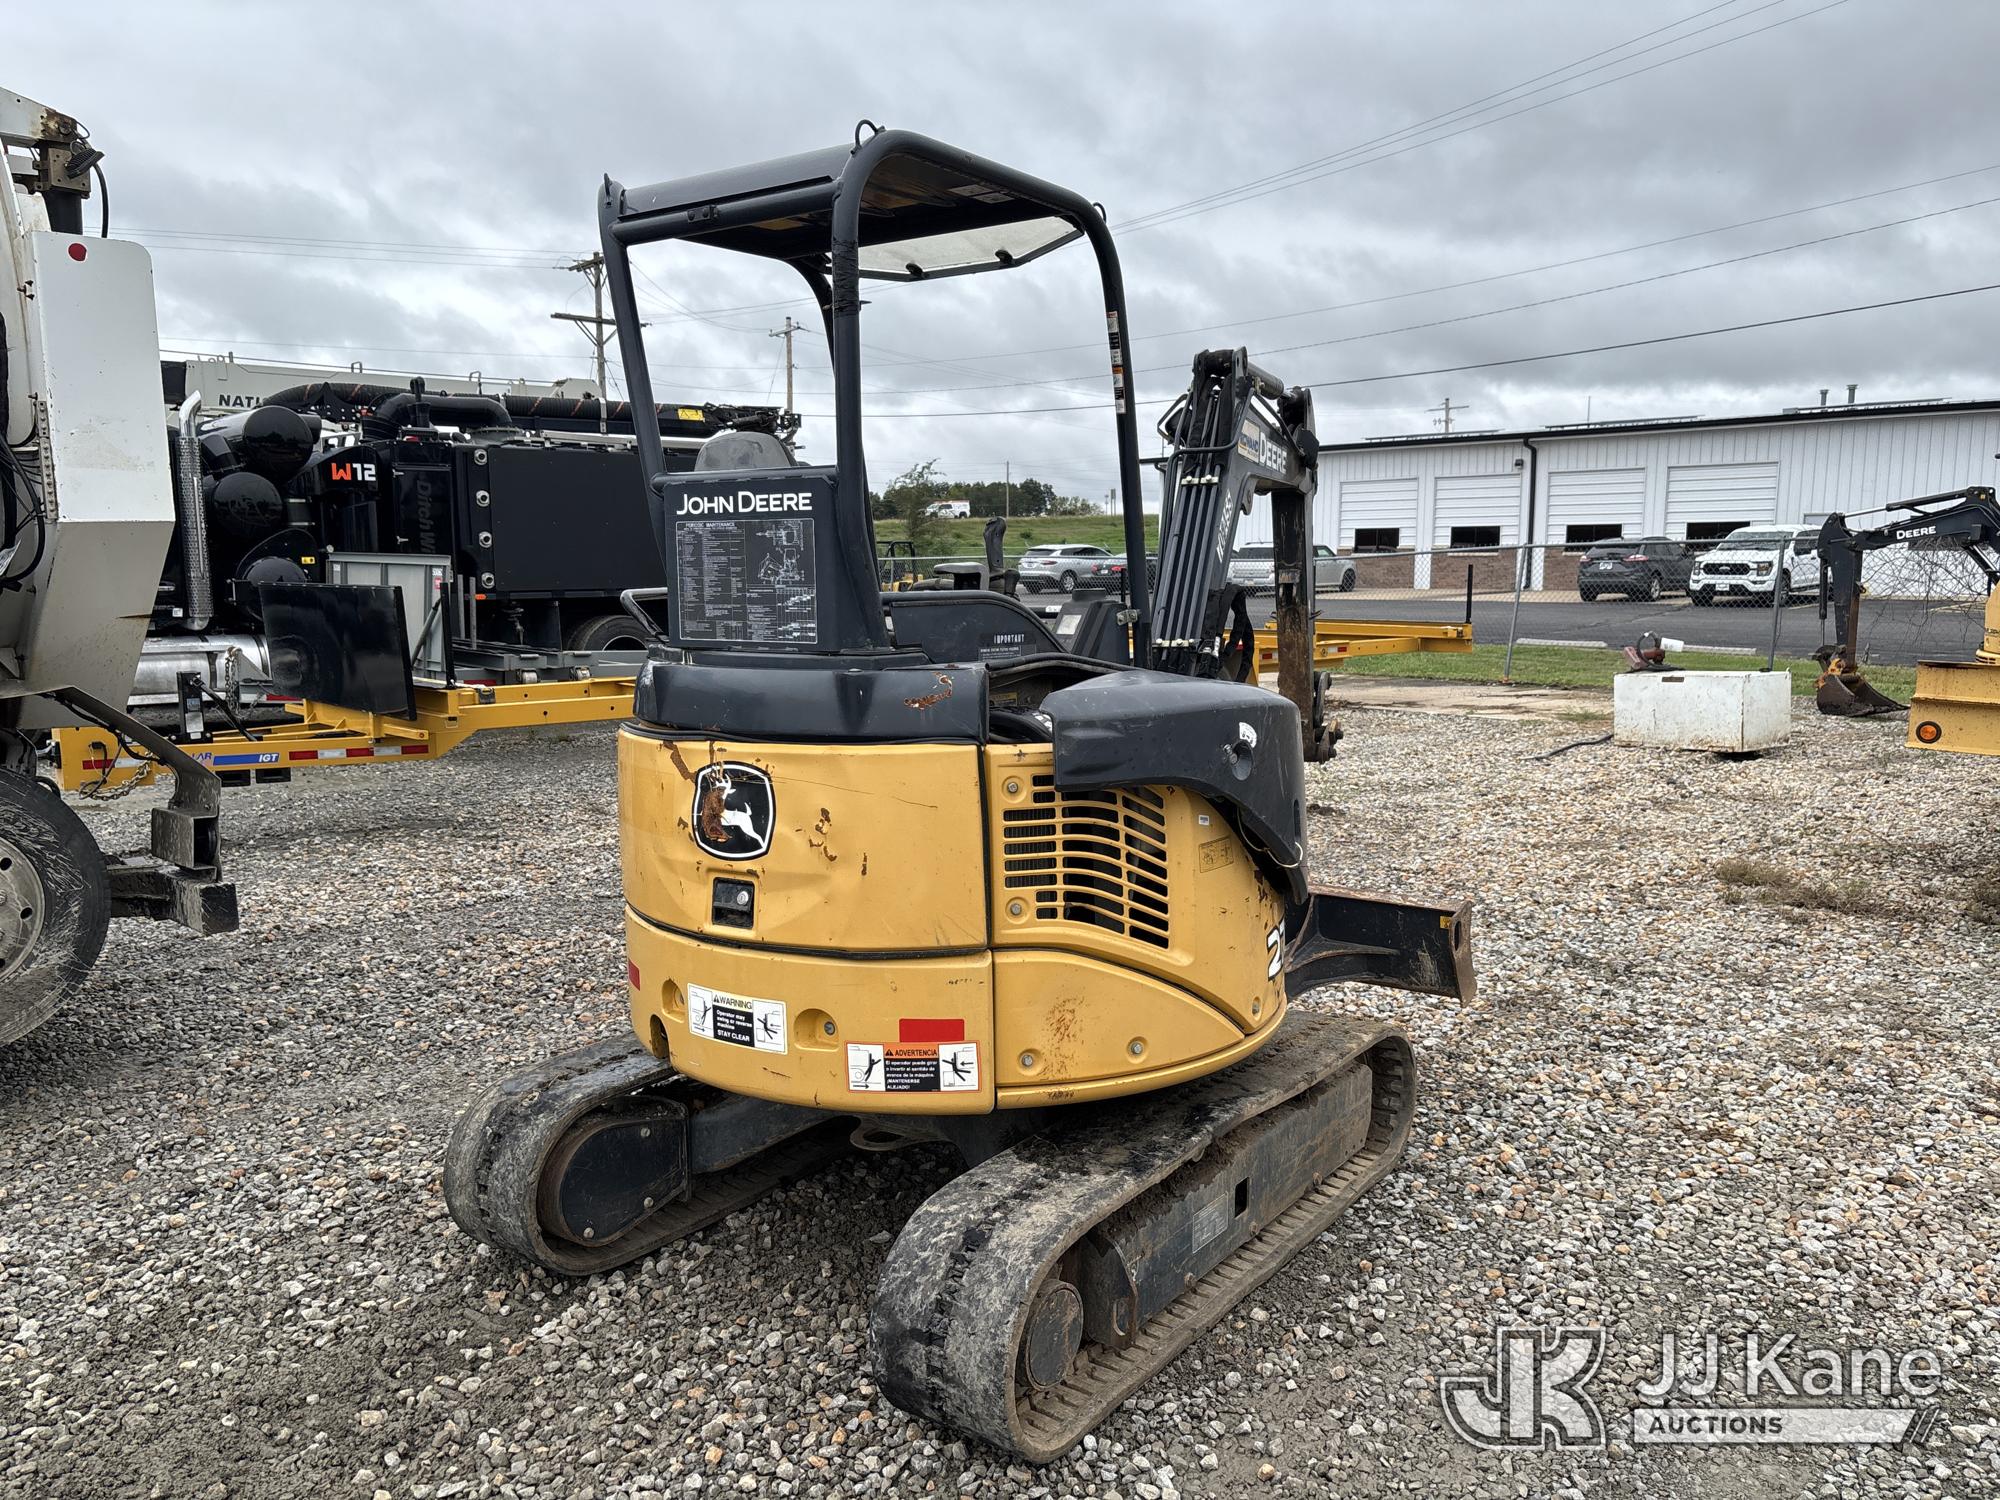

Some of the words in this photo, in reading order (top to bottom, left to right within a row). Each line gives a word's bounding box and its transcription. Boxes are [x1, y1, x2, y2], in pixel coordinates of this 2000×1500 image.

[1259, 431, 1287, 475] DEERE
[331, 462, 377, 481] W12
[416, 480, 434, 531] Ditch
[676, 493, 734, 515] JOHN
[737, 491, 813, 513] DEERE
[1896, 525, 1936, 540] DEERE
[993, 633, 1025, 644] IMPORTANT
[258, 753, 280, 763] IGT
[719, 995, 753, 1010] WARNING
[716, 1010, 735, 1019] Operator
[716, 1016, 729, 1024] swing
[735, 1020, 753, 1028] reverse
[716, 1022, 735, 1030] machine
[717, 1029, 731, 1038] STAY
[731, 1032, 750, 1042] CLEAR
[895, 1049, 938, 1057] ADVERTENCIA
